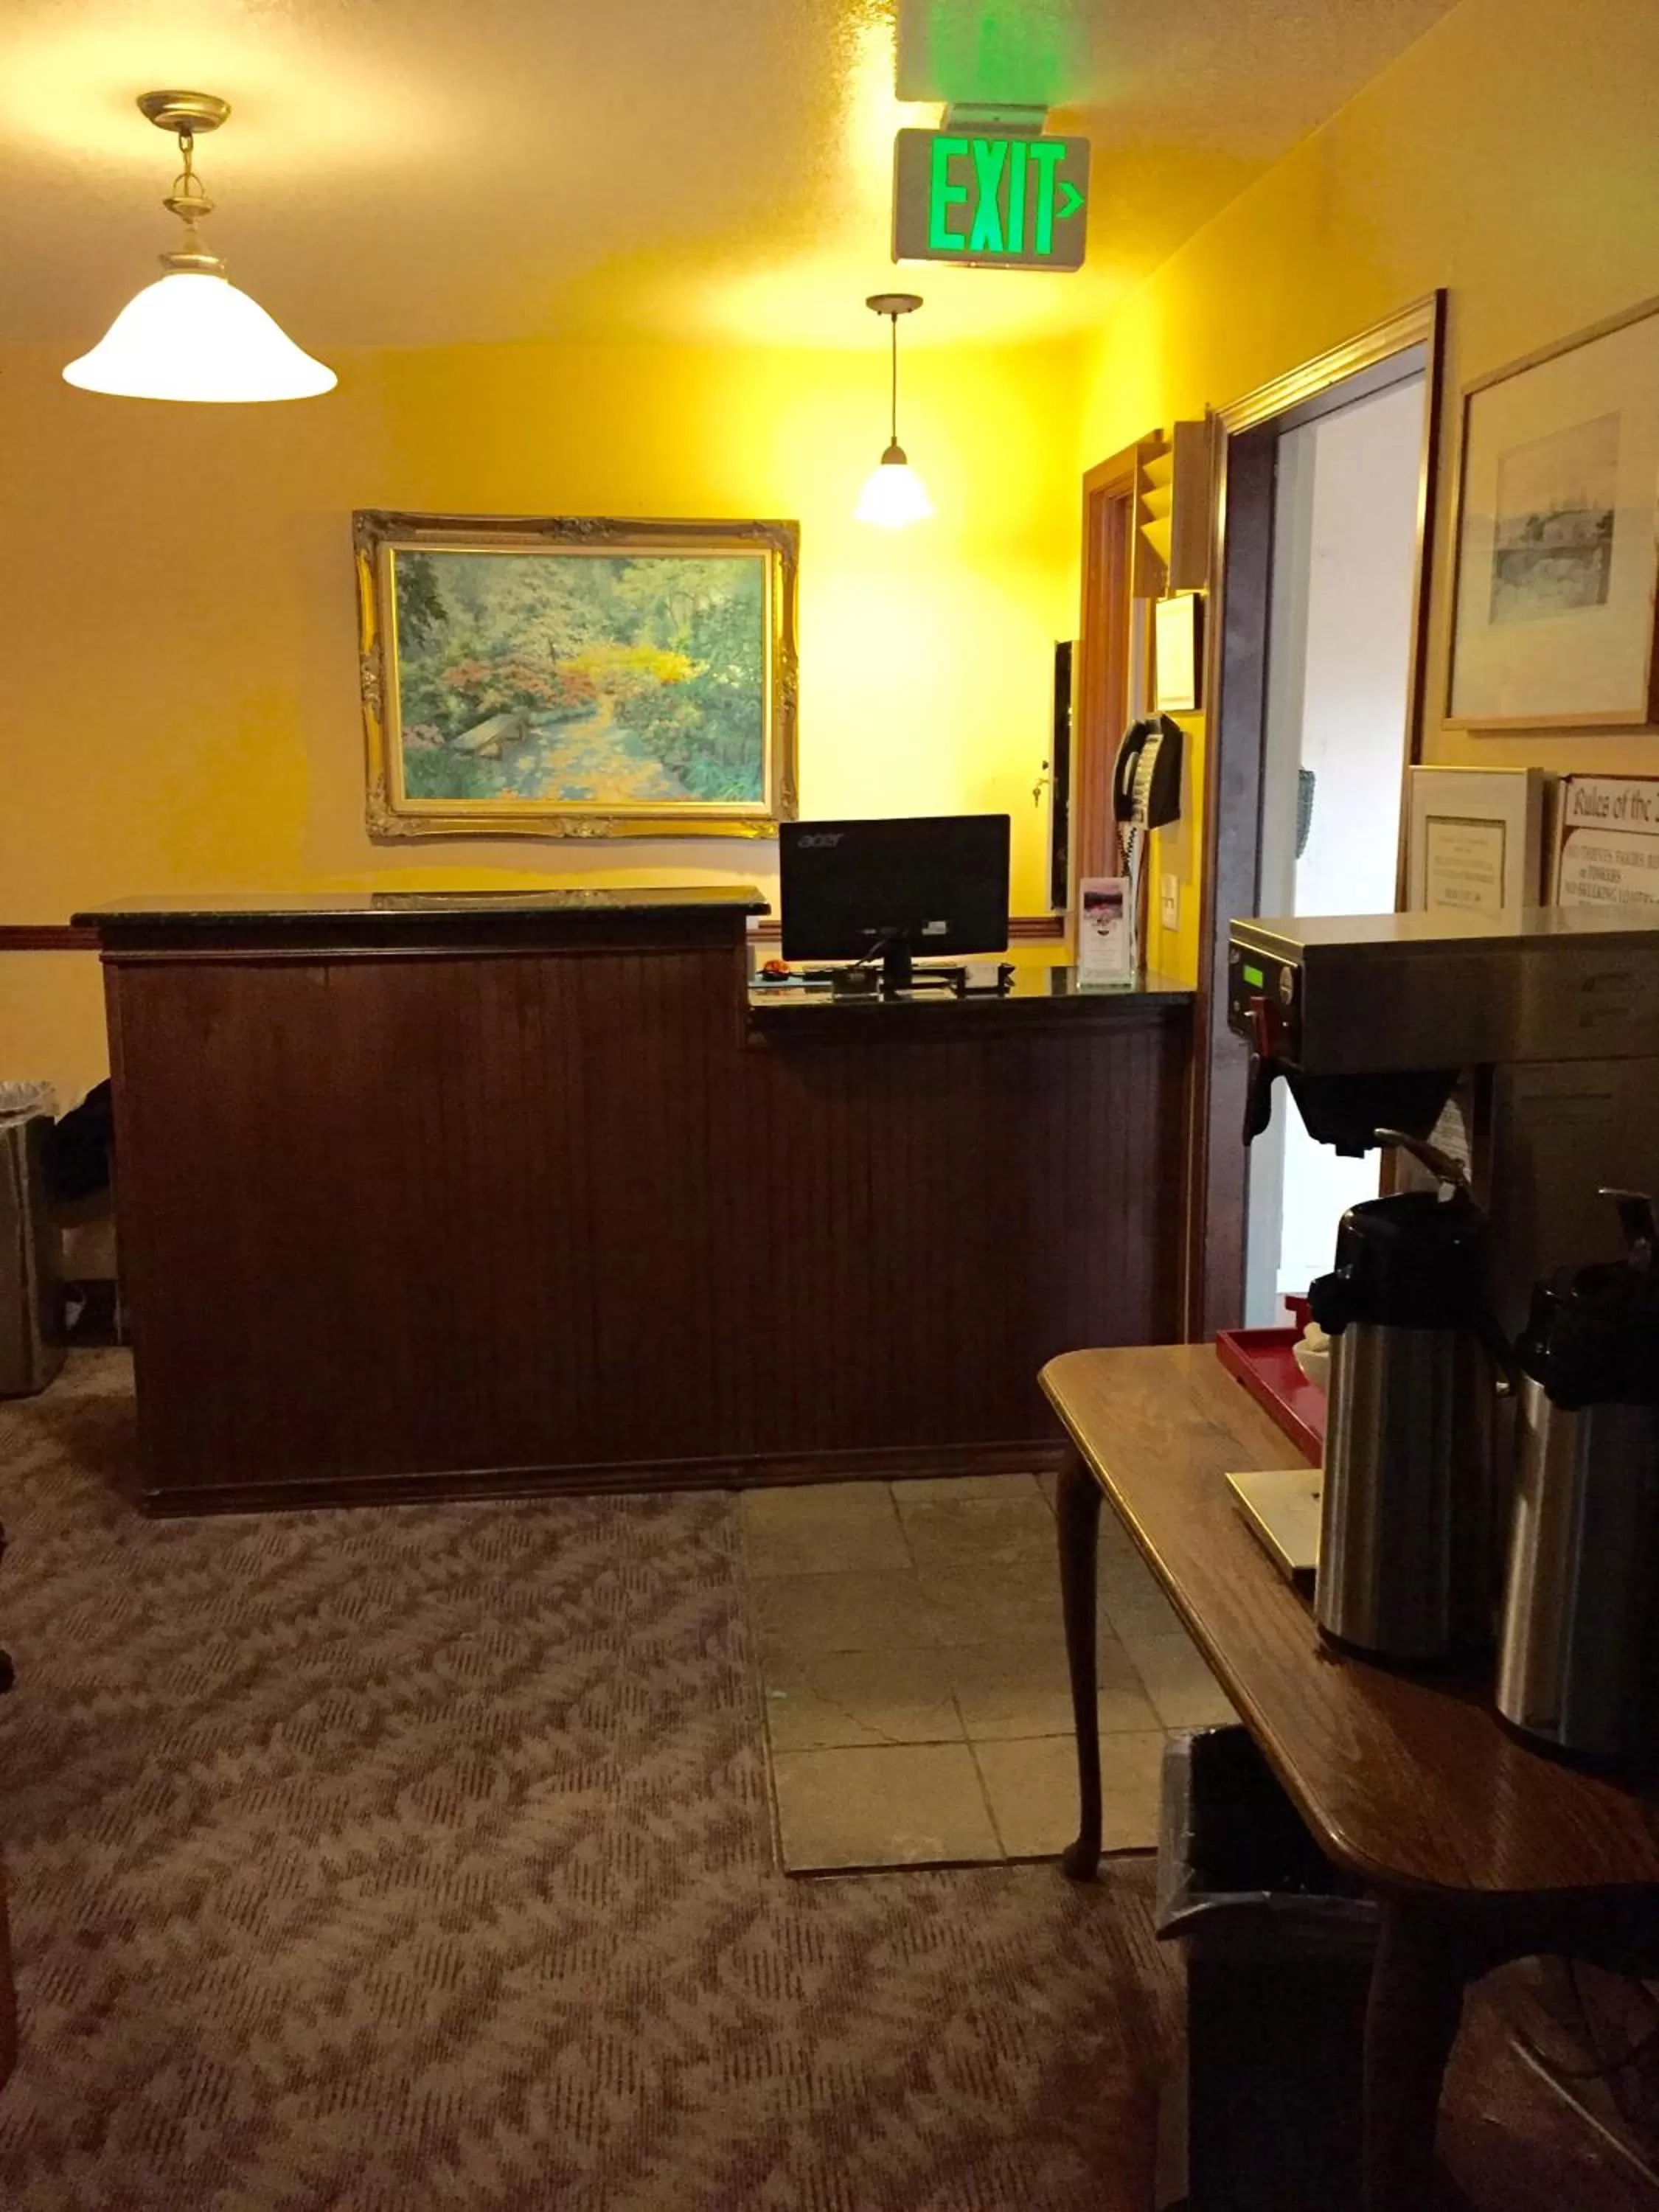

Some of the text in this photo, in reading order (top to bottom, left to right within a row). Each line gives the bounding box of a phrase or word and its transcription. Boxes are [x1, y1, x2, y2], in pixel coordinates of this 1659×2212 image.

[928, 136, 1066, 256] EXIT
[1573, 786, 1609, 818] Rules
[1613, 788, 1630, 820] of
[1631, 789, 1652, 822] the
[796, 833, 845, 849] acer
